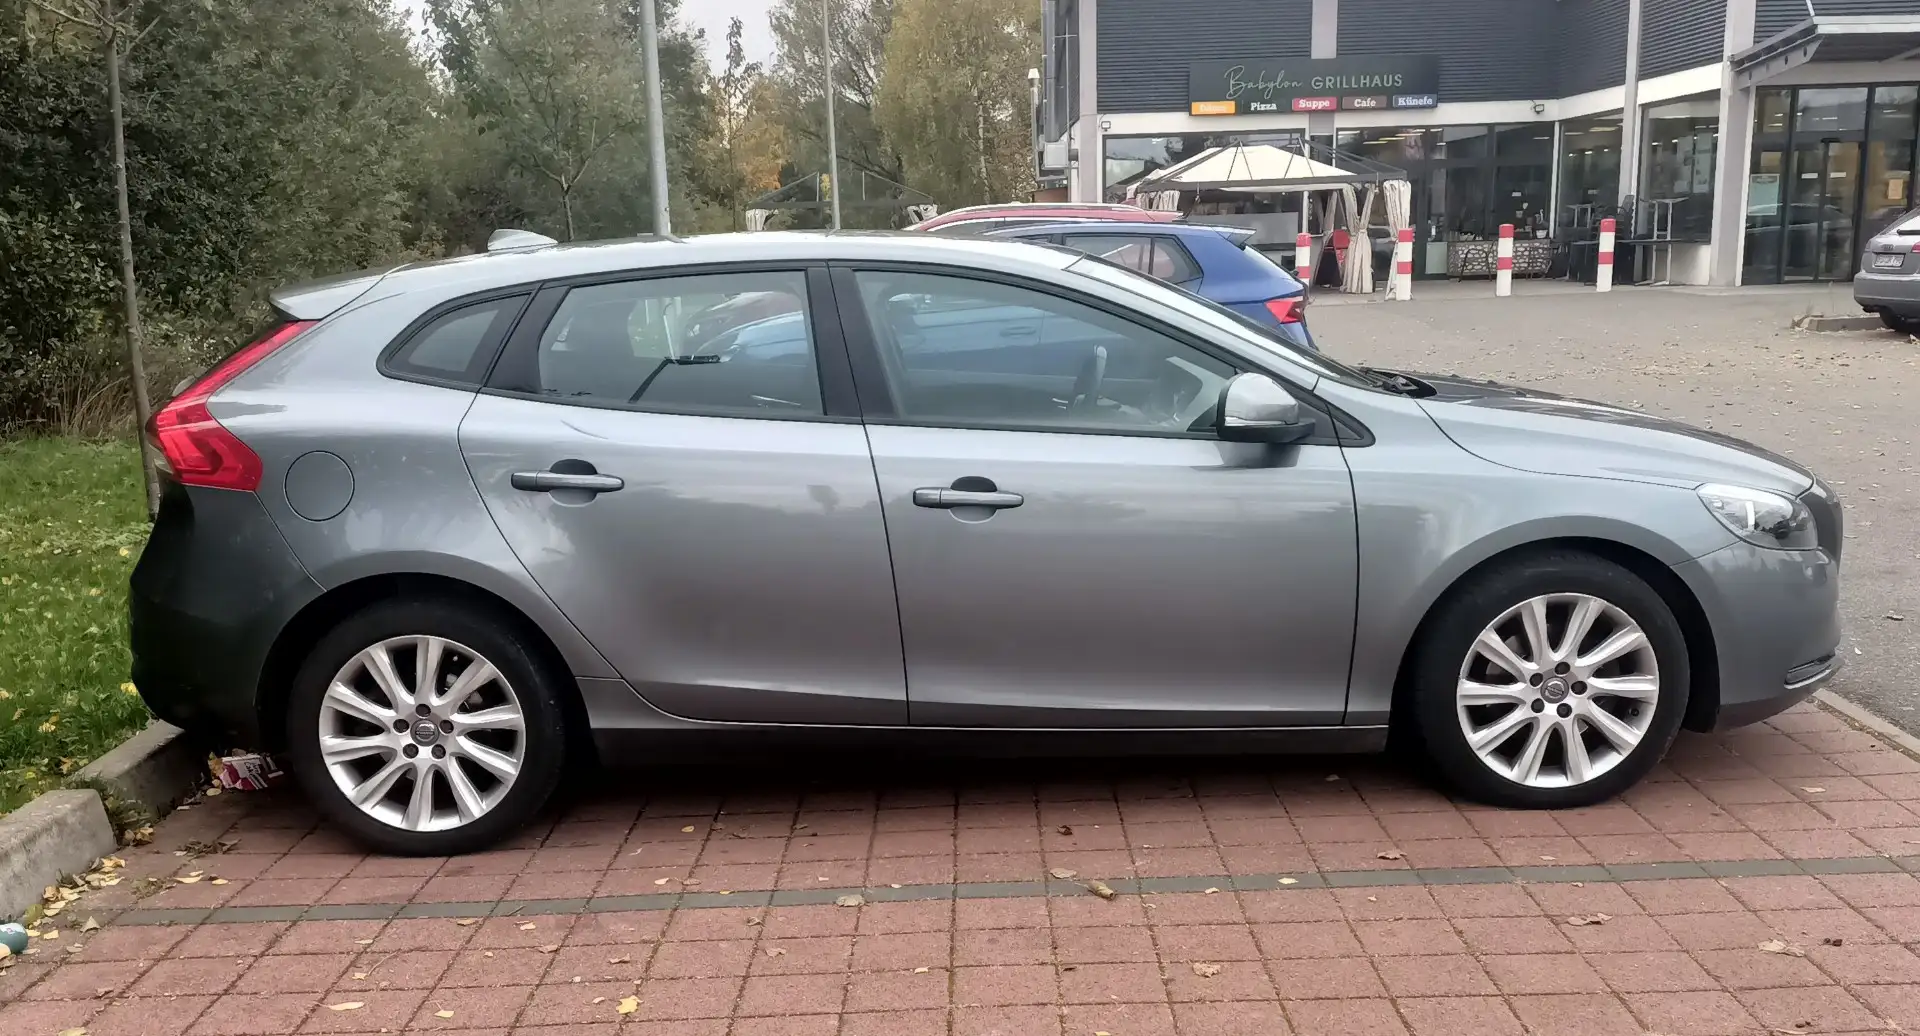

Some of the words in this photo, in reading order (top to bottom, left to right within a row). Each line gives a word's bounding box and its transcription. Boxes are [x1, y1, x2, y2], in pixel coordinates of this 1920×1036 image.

[1224, 65, 1303, 99] Babylon
[1311, 74, 1403, 89] GRILLHAUS
[1298, 98, 1331, 109] Suppe
[1397, 95, 1433, 106] Künefe
[1250, 102, 1277, 111] Pizza
